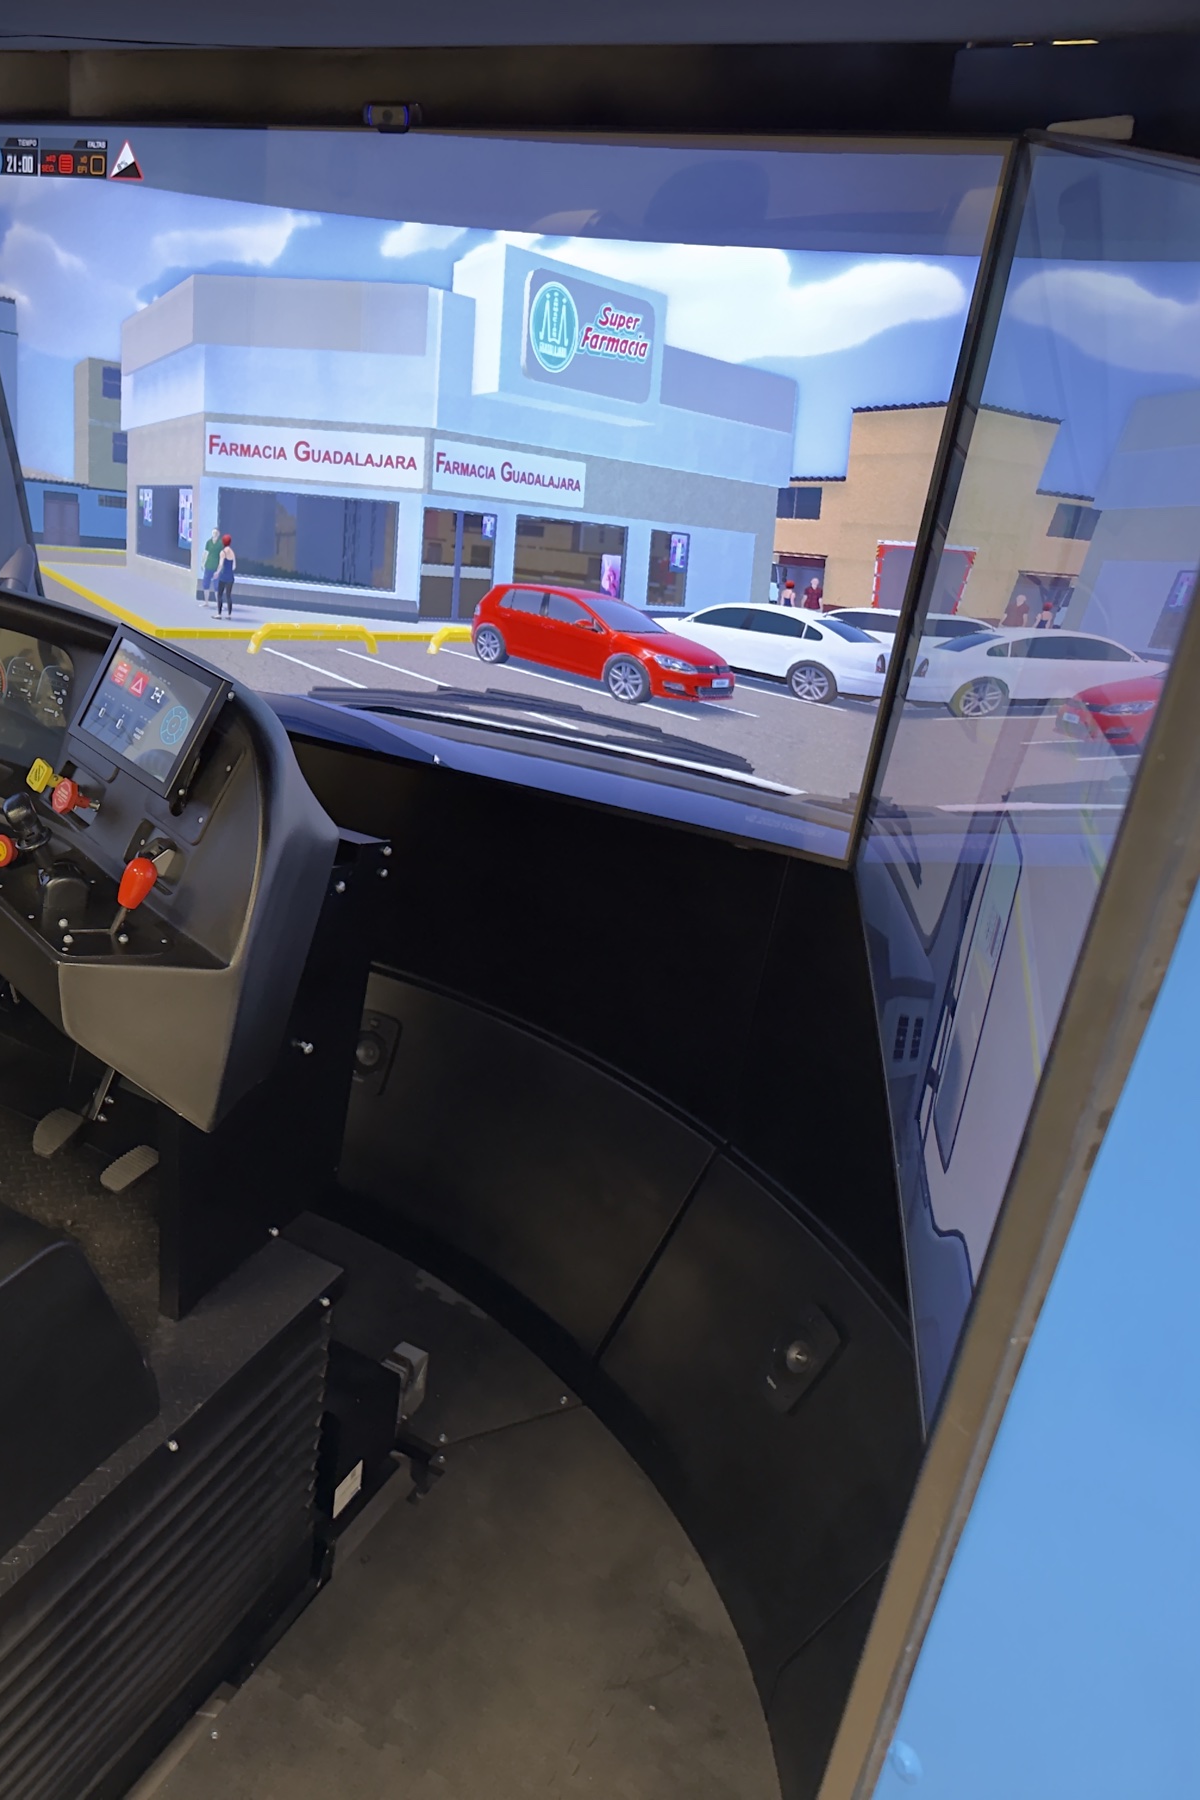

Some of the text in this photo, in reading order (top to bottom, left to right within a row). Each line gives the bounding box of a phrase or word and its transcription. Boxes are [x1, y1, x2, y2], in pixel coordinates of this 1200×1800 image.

[6, 155, 34, 173] 21:00
[598, 306, 641, 331] Super
[581, 326, 649, 358] Farmacia
[208, 434, 418, 471] FARMACIA GUADALAJARA
[435, 451, 581, 492] FARMACIA GUADALAJARA
